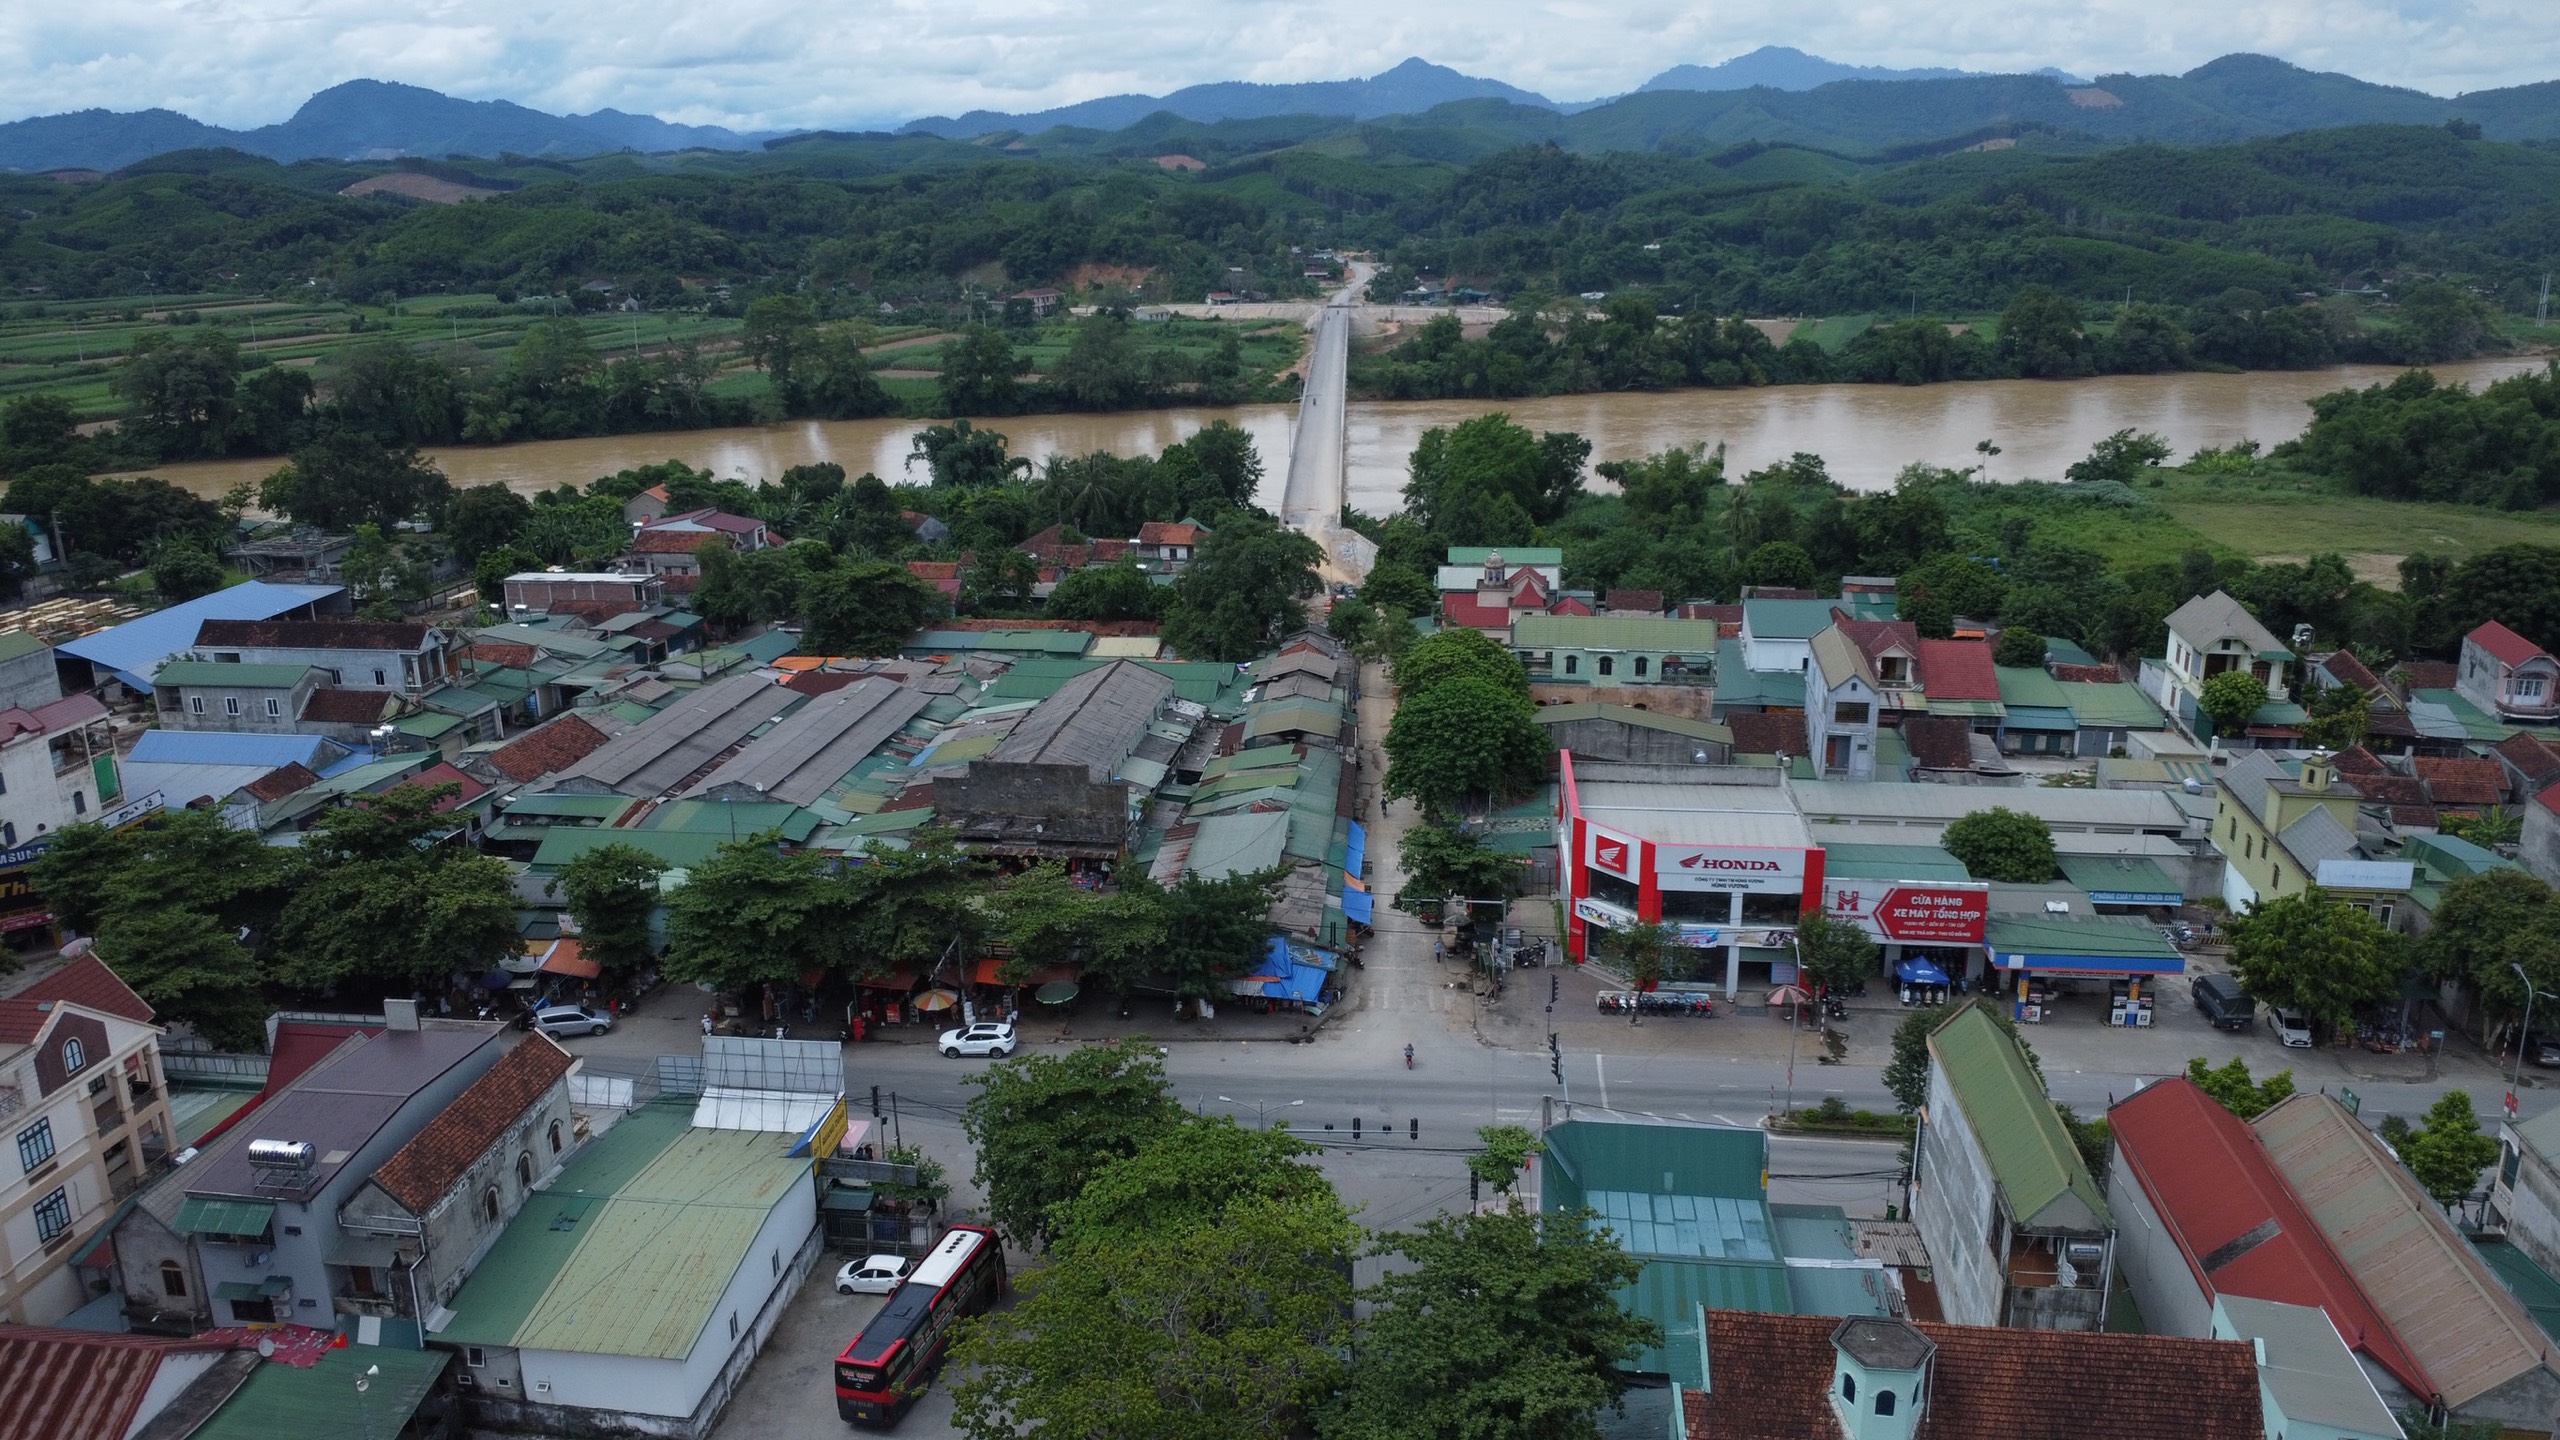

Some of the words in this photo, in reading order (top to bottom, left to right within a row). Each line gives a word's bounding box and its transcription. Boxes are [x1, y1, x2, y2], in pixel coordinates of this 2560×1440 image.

[1599, 857, 1620, 869] HONDA
[1702, 859, 1782, 871] HONDA
[1911, 894, 1932, 905] CỬA
[1934, 895, 1963, 906] HÀNG
[1893, 908, 1907, 918] XE
[1908, 907, 1931, 918] MÁY
[1932, 906, 1959, 919] TỔNG
[1959, 910, 1981, 922] HỢP
